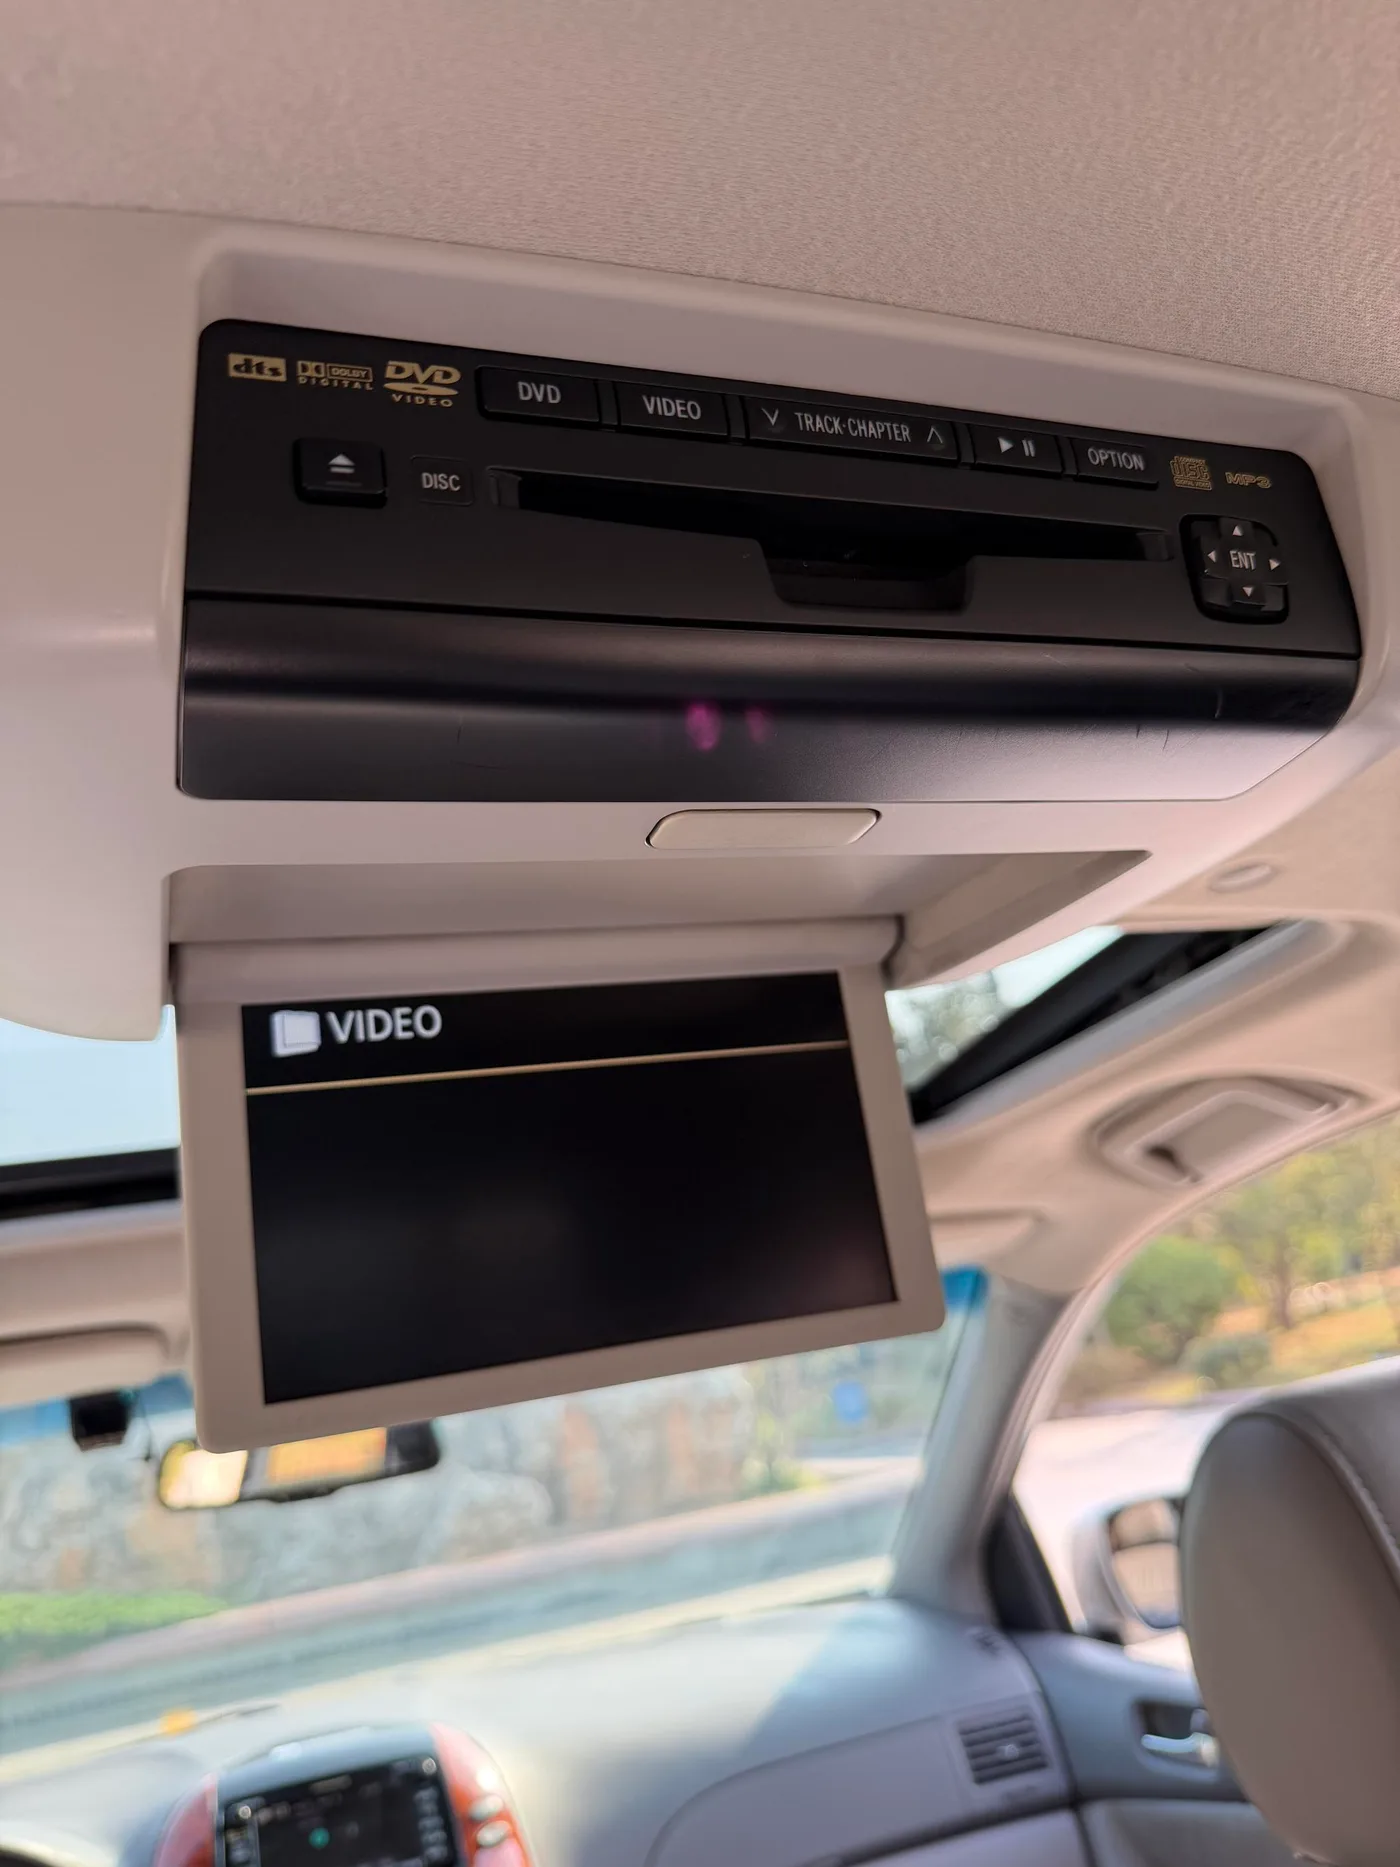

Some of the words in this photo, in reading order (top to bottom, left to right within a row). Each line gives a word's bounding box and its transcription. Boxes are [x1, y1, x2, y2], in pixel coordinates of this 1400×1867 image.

[232, 358, 283, 377] dts
[331, 367, 368, 379] DOLBY
[385, 361, 462, 384] DVD
[298, 376, 374, 391] DIGITAL
[517, 381, 562, 404] DVD
[391, 393, 454, 408] VIDEO
[642, 395, 702, 420] VIDEO
[1087, 447, 1145, 471] OPTION
[421, 472, 461, 491] DISC
[1225, 472, 1272, 488] MP3
[1229, 550, 1257, 570] ENT
[325, 1004, 443, 1044] VIDEO
